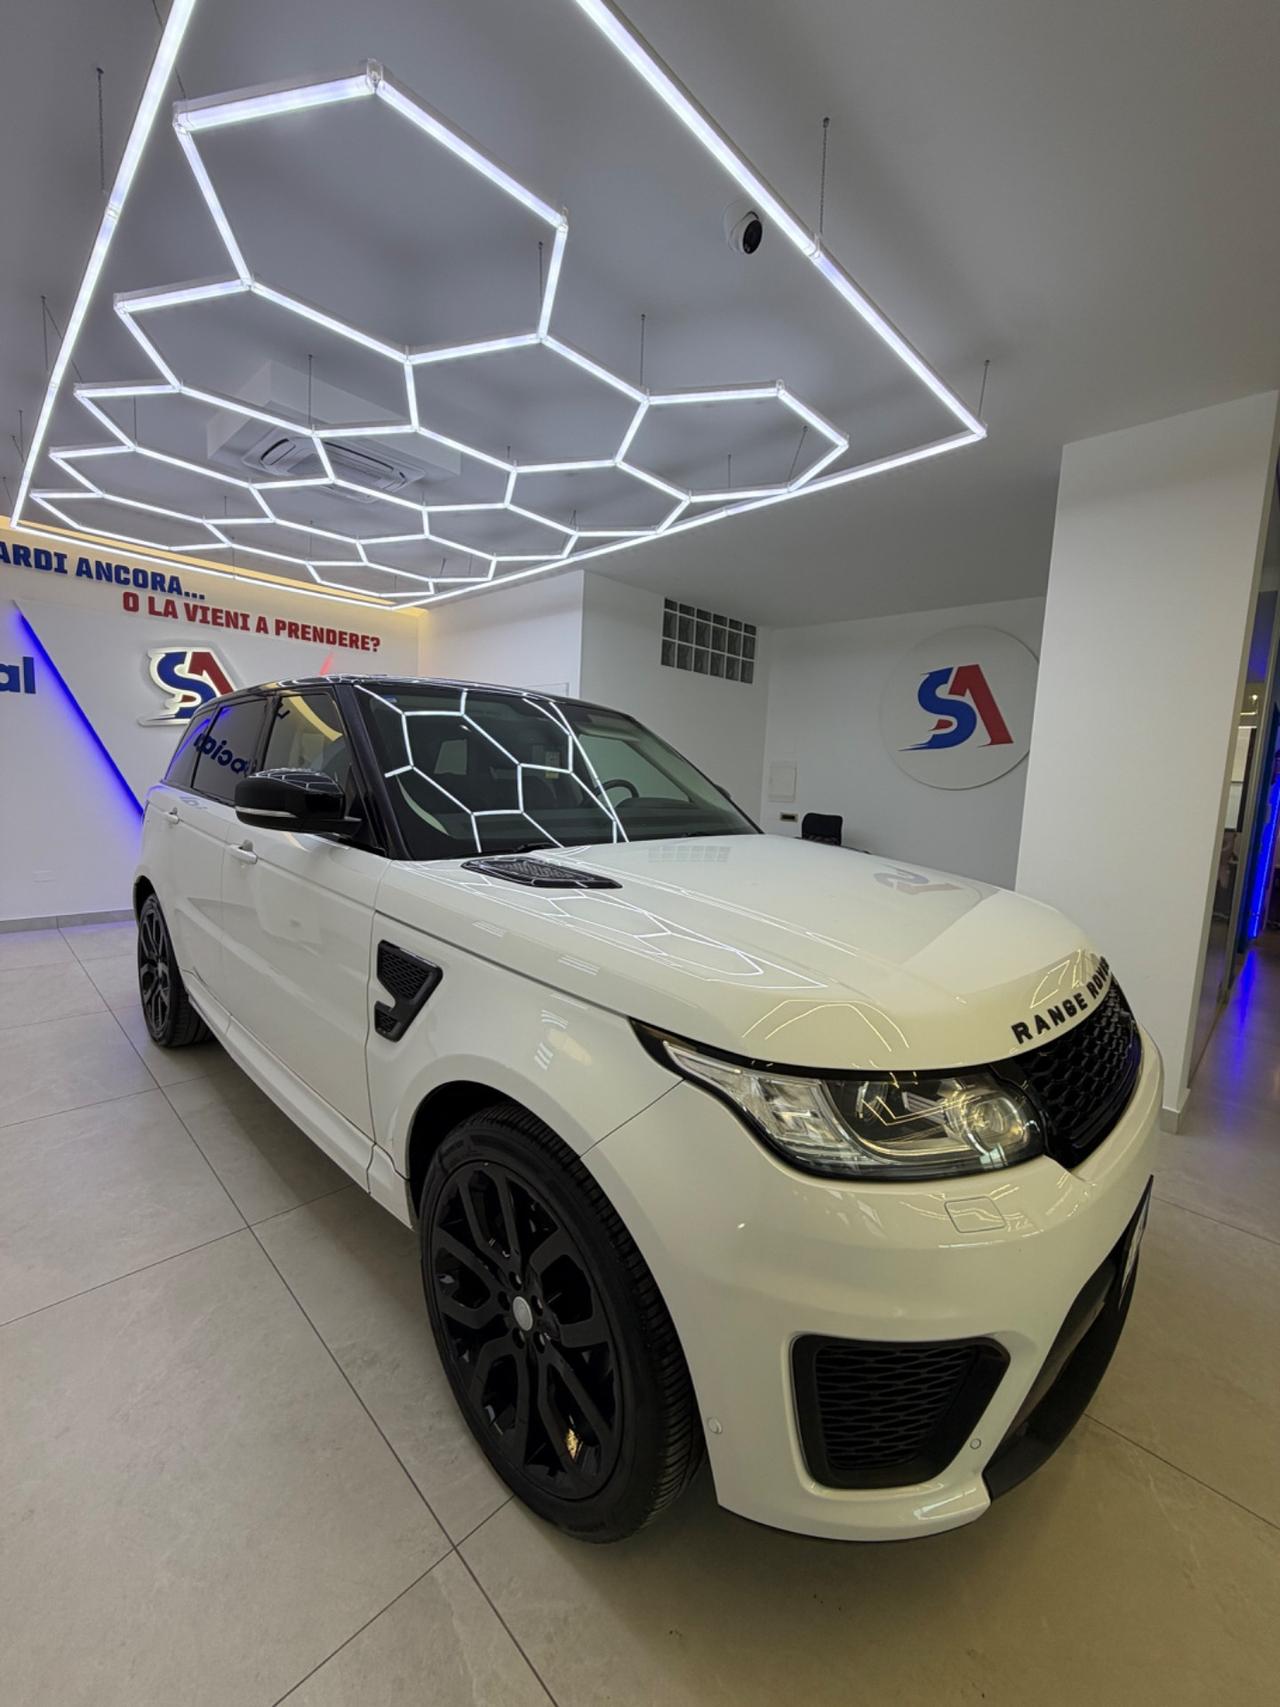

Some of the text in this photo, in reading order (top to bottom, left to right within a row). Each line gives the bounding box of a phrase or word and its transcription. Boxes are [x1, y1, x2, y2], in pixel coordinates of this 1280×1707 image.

[76, 557, 205, 600] ANCORA...
[123, 591, 380, 652] O LA VIENI A PRENDERE?
[898, 664, 1014, 751] SA
[1011, 992, 1088, 1044] RANGE
